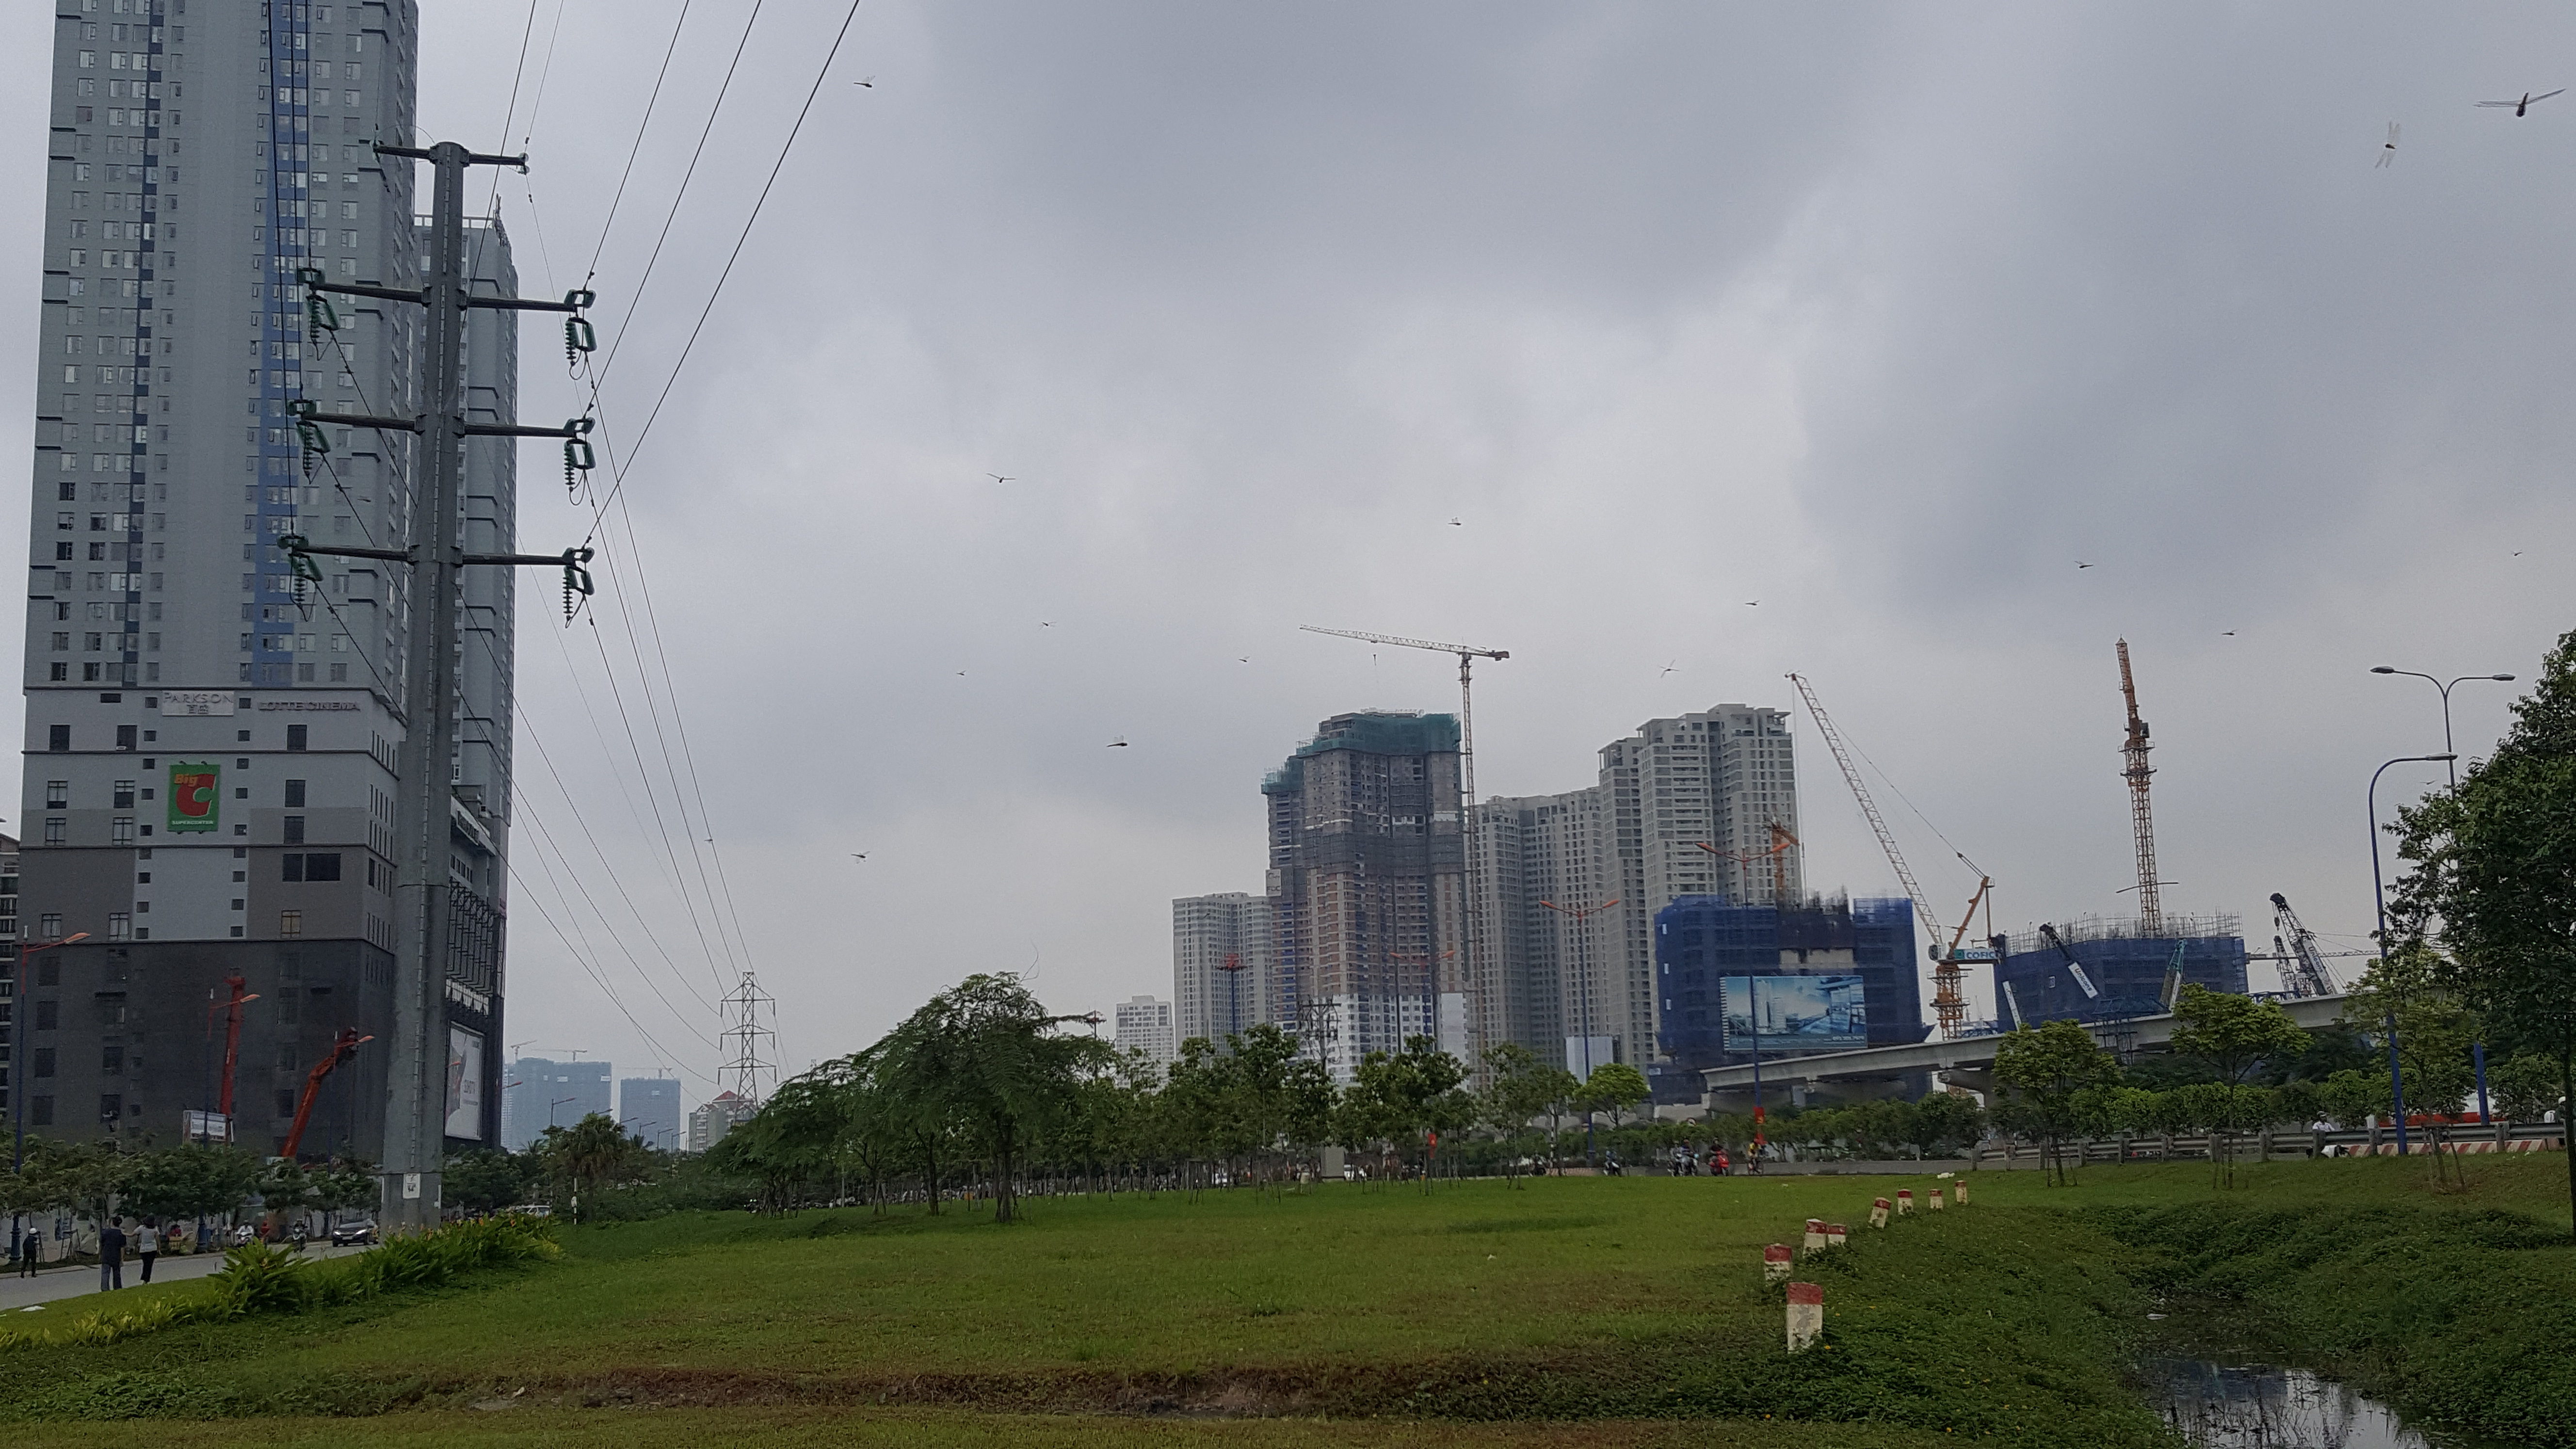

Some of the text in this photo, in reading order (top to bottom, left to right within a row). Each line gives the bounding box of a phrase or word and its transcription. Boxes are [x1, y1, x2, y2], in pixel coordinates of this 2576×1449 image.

[162, 692, 233, 703] PARKSON
[258, 702, 361, 711] LOTTE CINEMA
[174, 773, 199, 787] Big
[175, 773, 216, 818] C
[2075, 968, 2093, 991] Unicons
